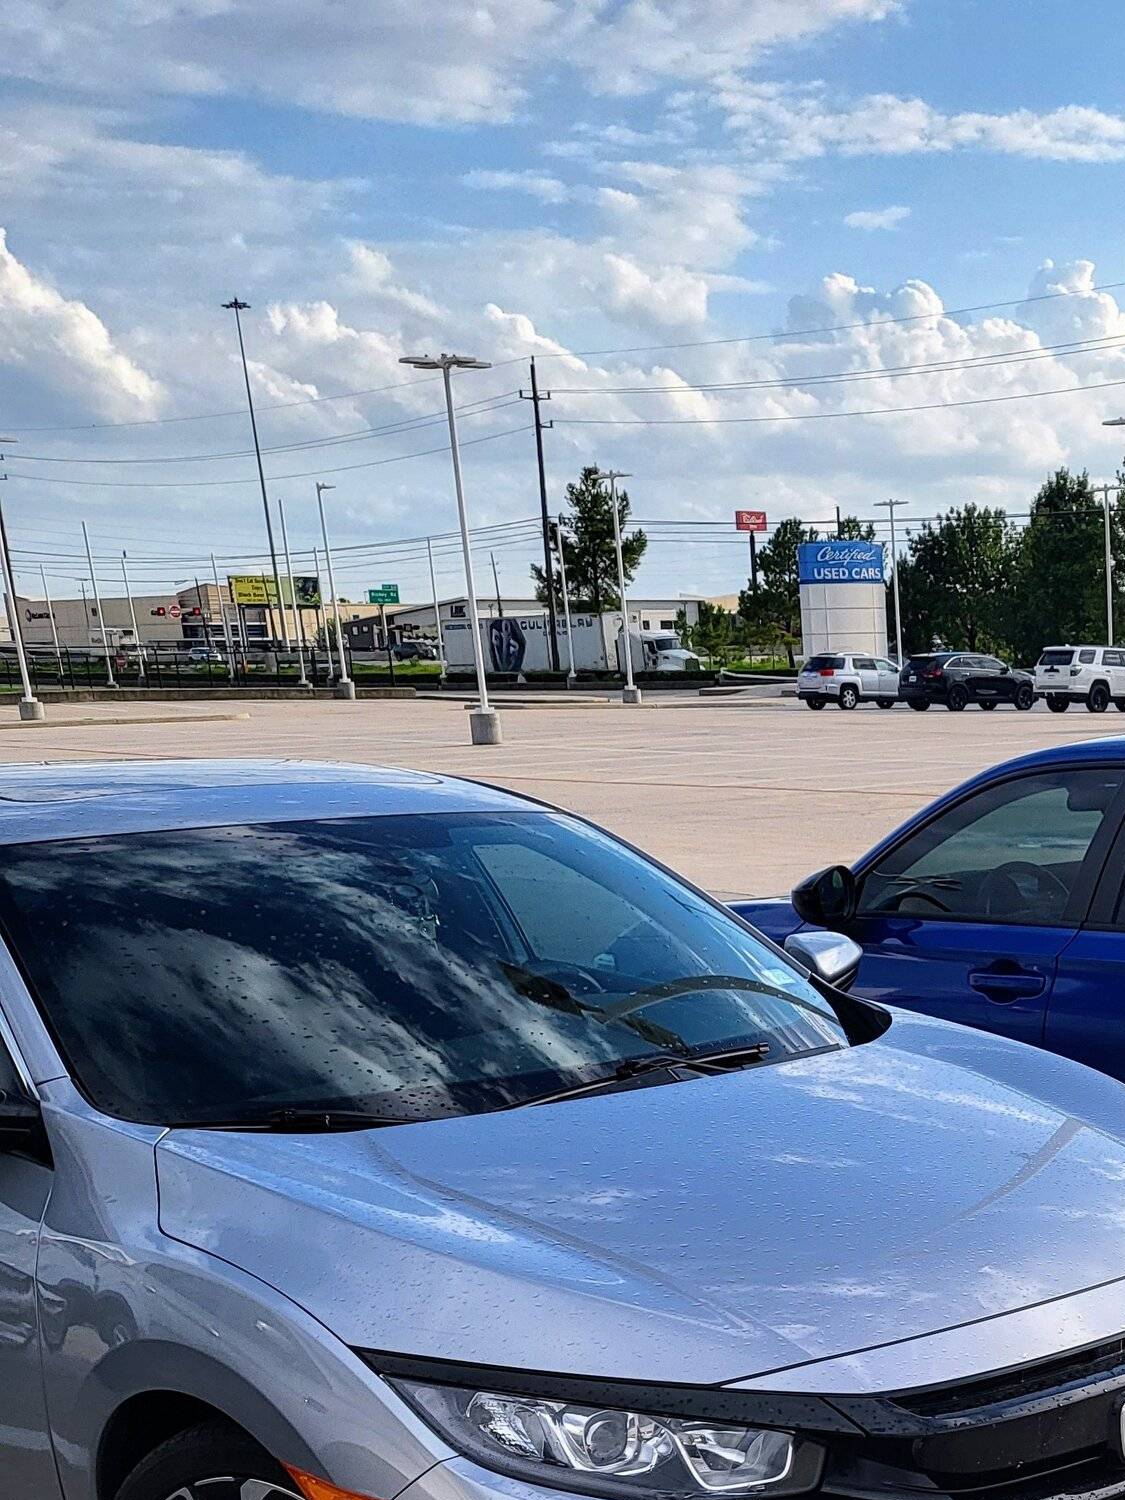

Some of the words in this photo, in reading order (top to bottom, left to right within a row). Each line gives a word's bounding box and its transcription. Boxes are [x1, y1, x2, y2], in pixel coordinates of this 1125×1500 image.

[816, 546, 877, 566] Certified
[814, 567, 849, 579] USED
[851, 567, 881, 579] CARS
